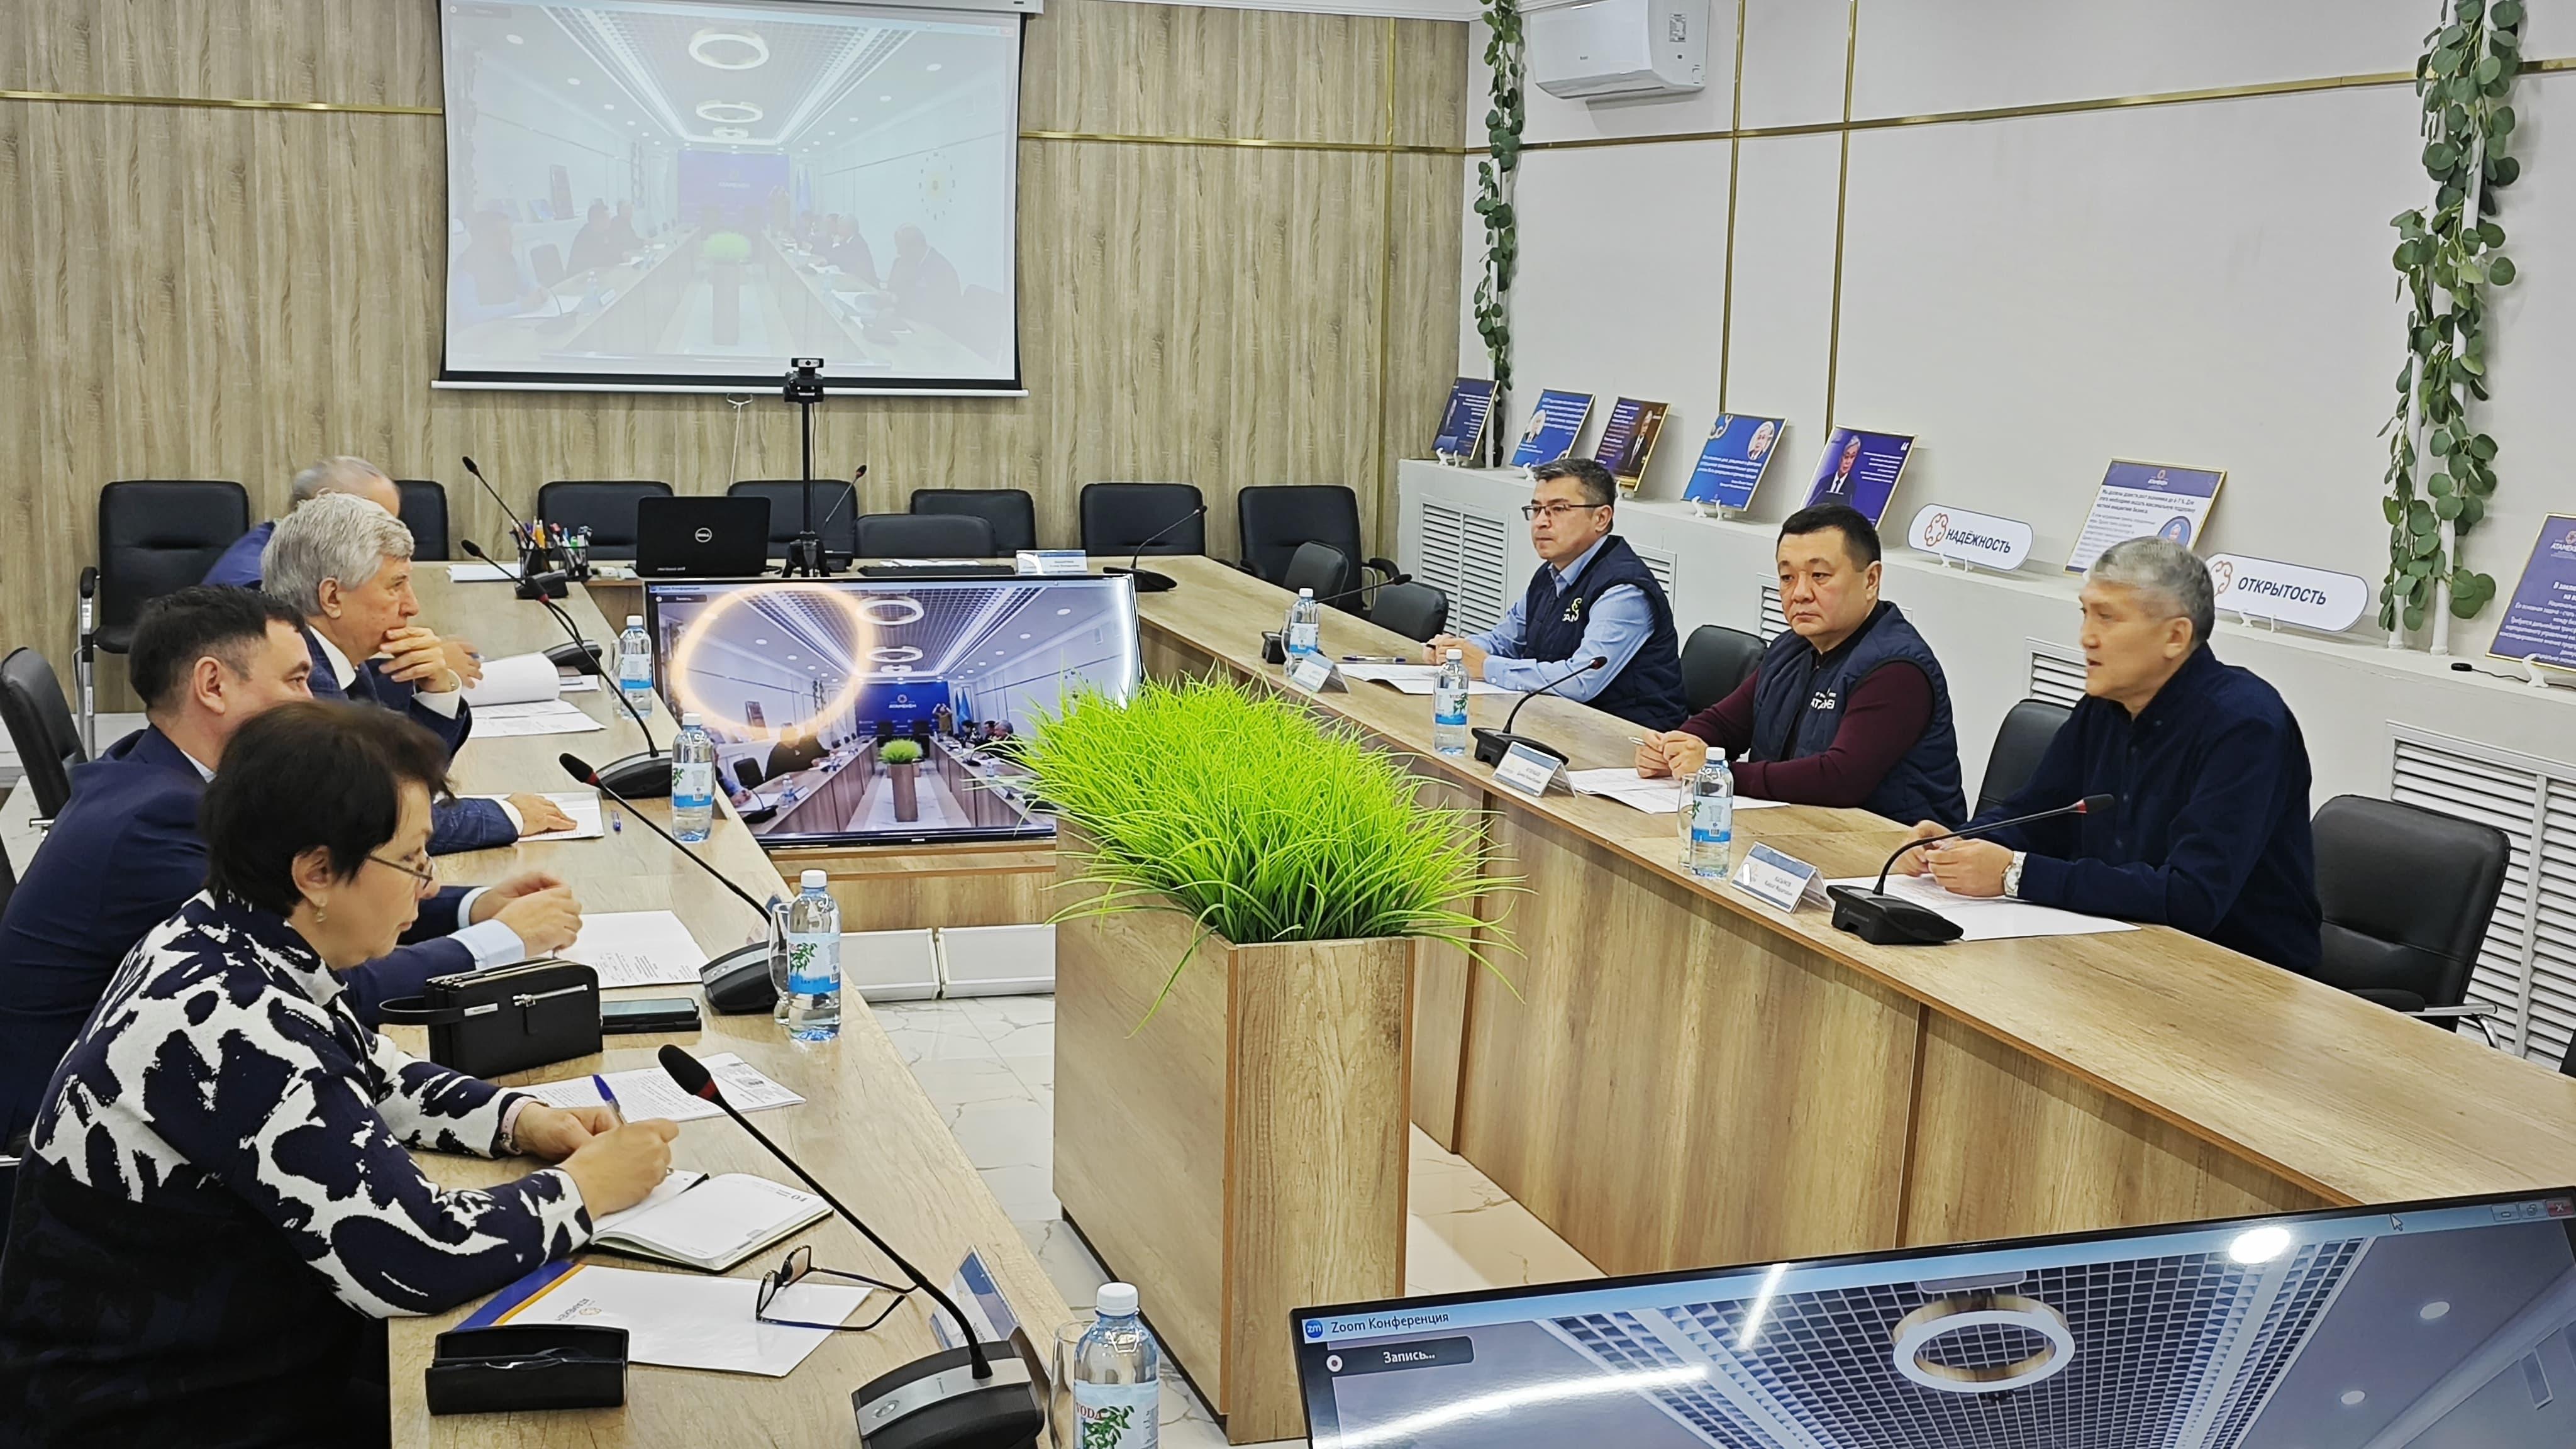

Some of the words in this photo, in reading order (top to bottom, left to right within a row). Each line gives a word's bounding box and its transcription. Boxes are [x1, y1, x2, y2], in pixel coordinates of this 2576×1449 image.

[1945, 528, 2011, 553] НАДЁЖНОСТЬ
[2238, 577, 2327, 605] ОТКРЫТОСТЬ
[1331, 1320, 1366, 1333] Zoom
[1368, 1314, 1449, 1330] Конференция
